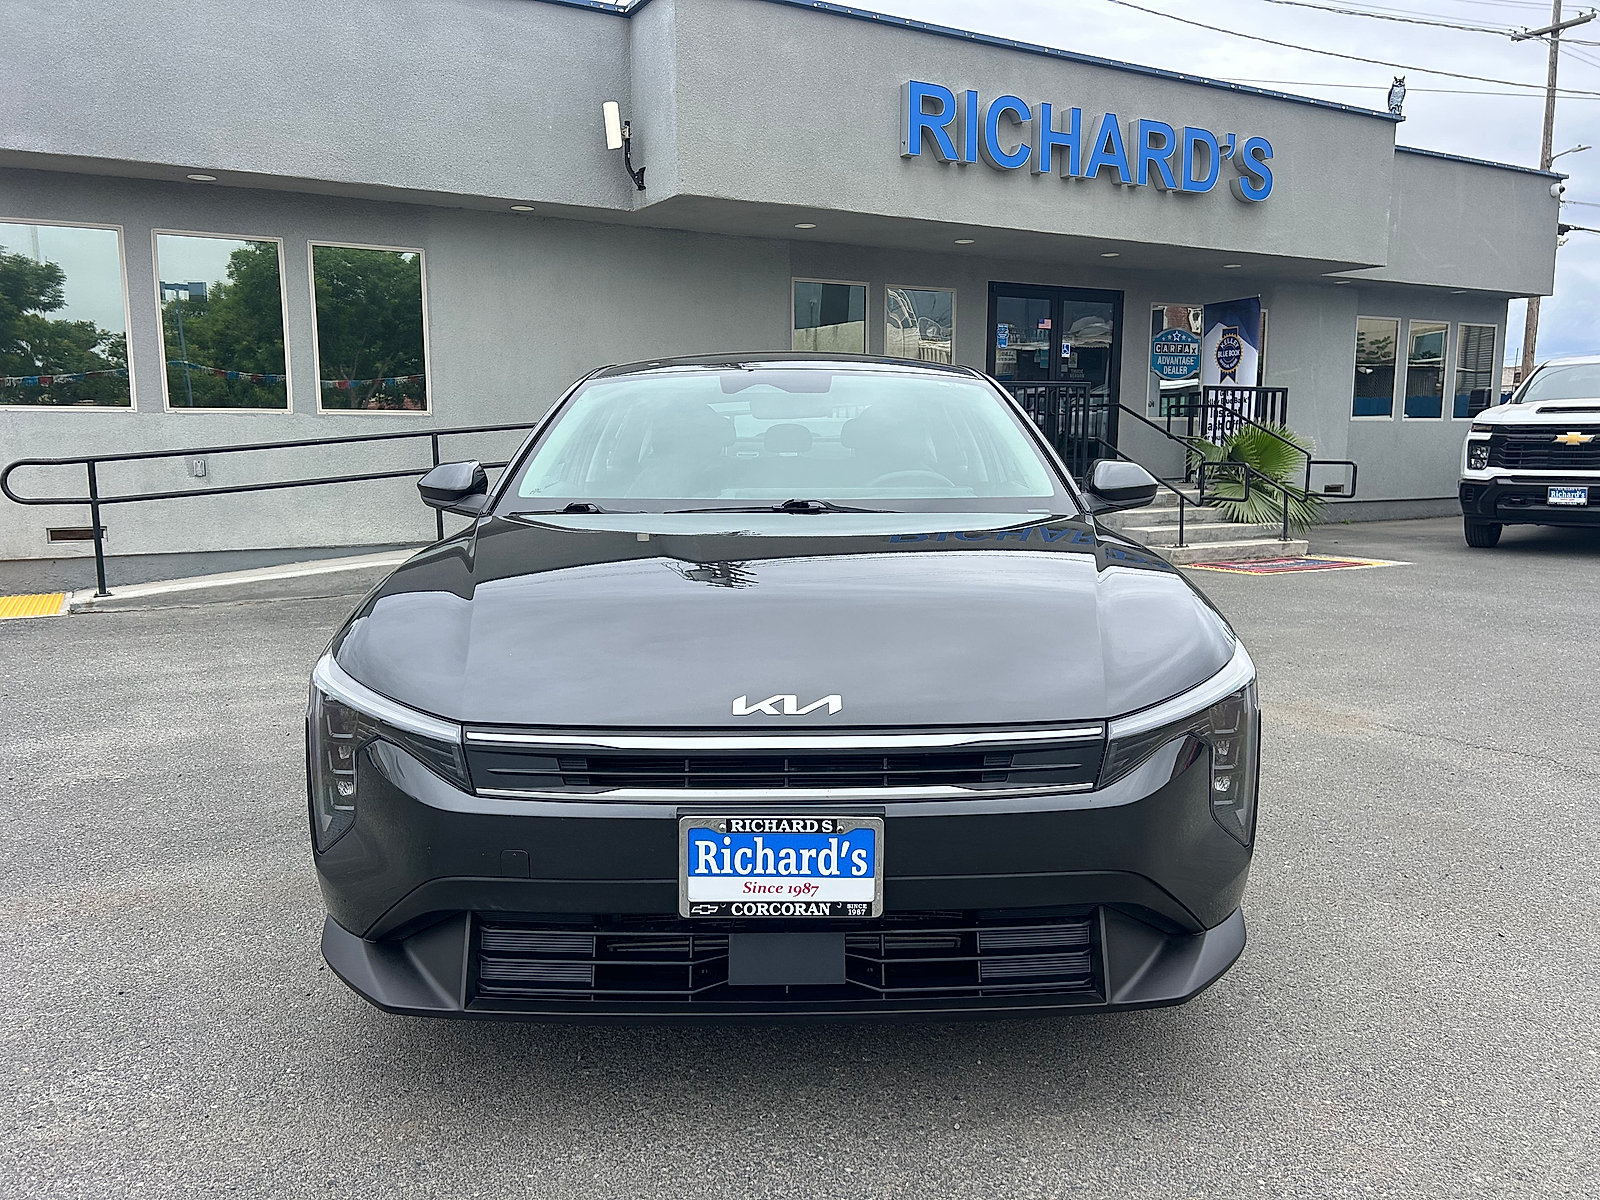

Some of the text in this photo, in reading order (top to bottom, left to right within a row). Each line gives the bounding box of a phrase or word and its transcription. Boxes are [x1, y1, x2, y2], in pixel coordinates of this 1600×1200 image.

[903, 80, 1273, 202] RICHARD'S
[1155, 343, 1197, 355] CARFAX
[1220, 337, 1239, 349] KELLEY
[1217, 349, 1240, 358] BLUE BOOK
[1157, 356, 1194, 365] ADVANTAGE
[1163, 366, 1187, 375] DEALER
[1550, 490, 1586, 498] Richard's
[694, 836, 868, 876] Richard's
[743, 881, 819, 897] Since 1987
[731, 902, 831, 916] CORCORAN
